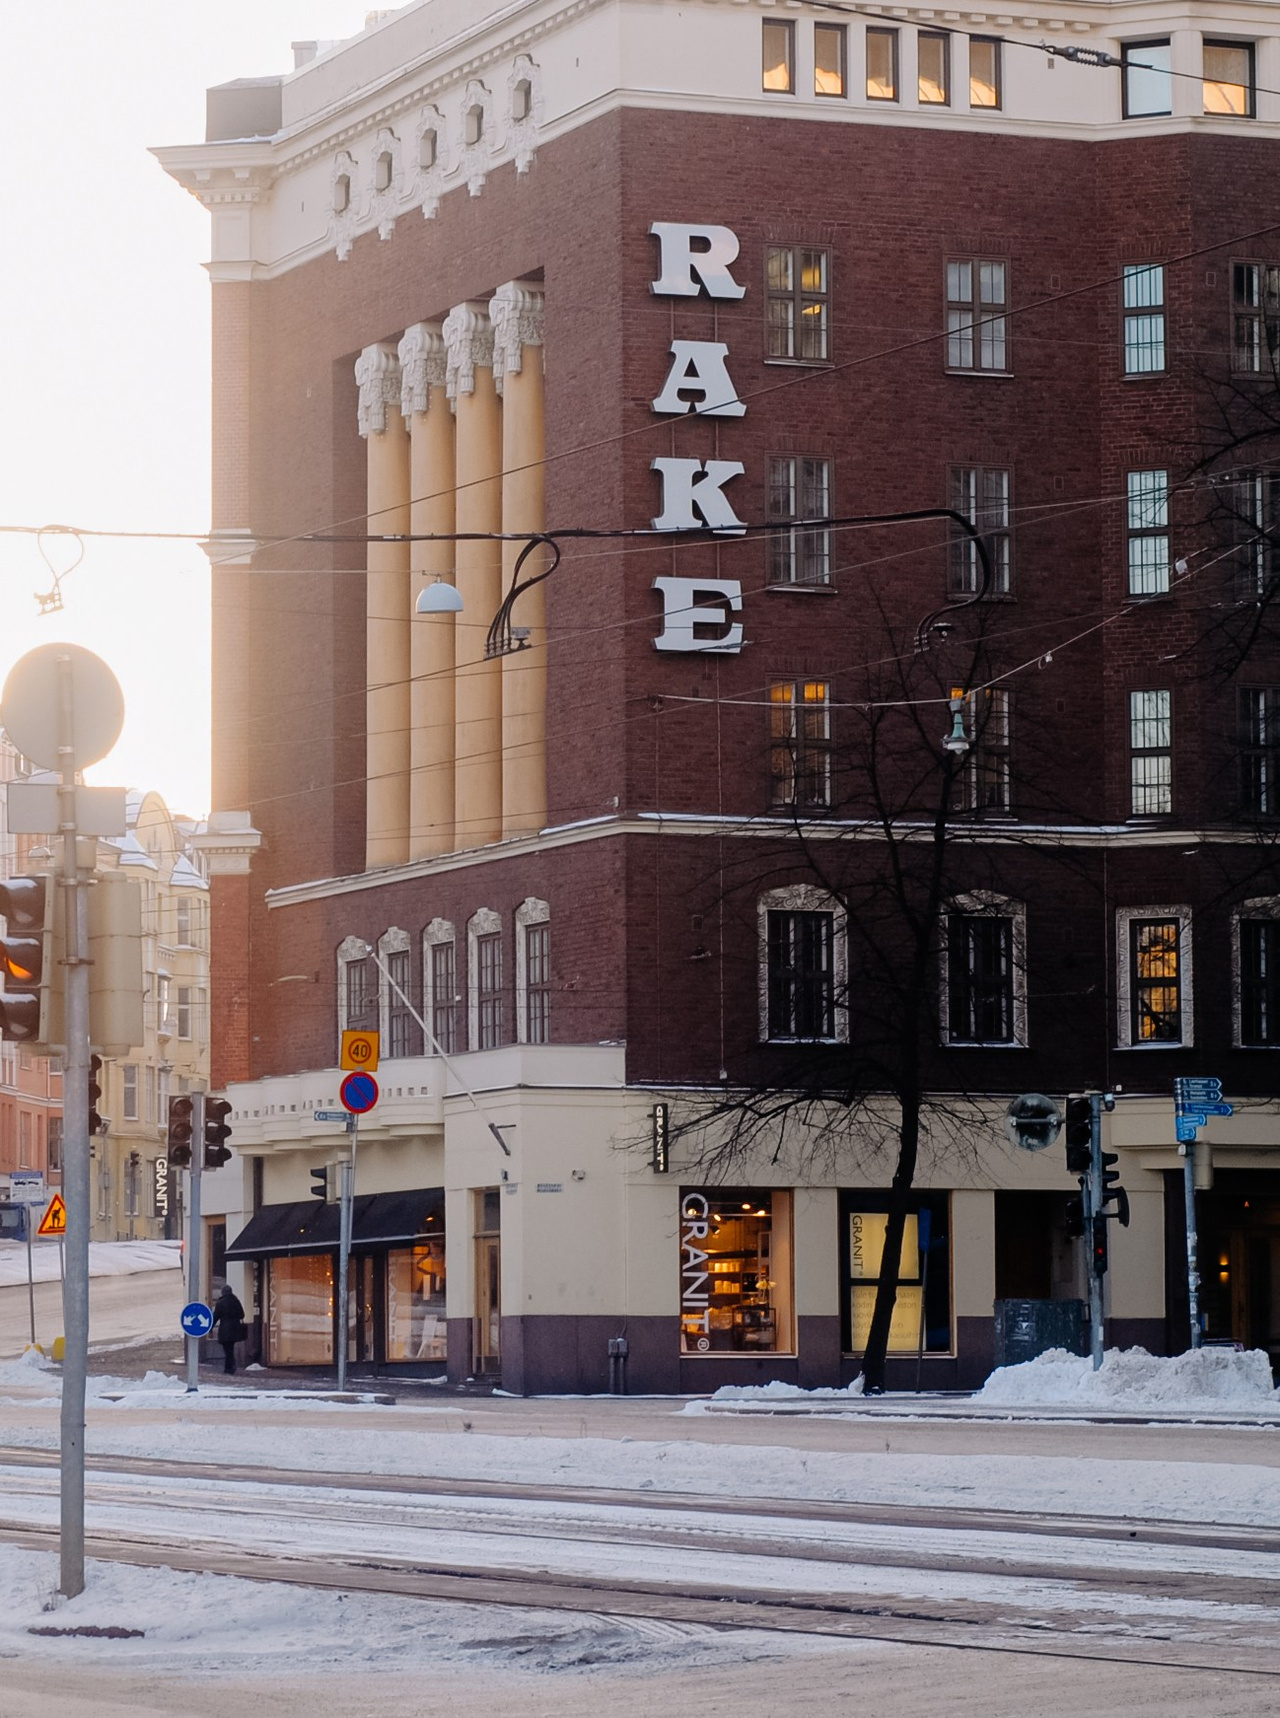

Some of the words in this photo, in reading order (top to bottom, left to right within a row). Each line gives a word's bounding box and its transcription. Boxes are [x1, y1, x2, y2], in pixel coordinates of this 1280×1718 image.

[649, 221, 748, 654] RAKE
[352, 1044, 368, 1058] 40
[156, 1158, 168, 1210] GRANIT
[852, 1214, 864, 1270] GRANIT
